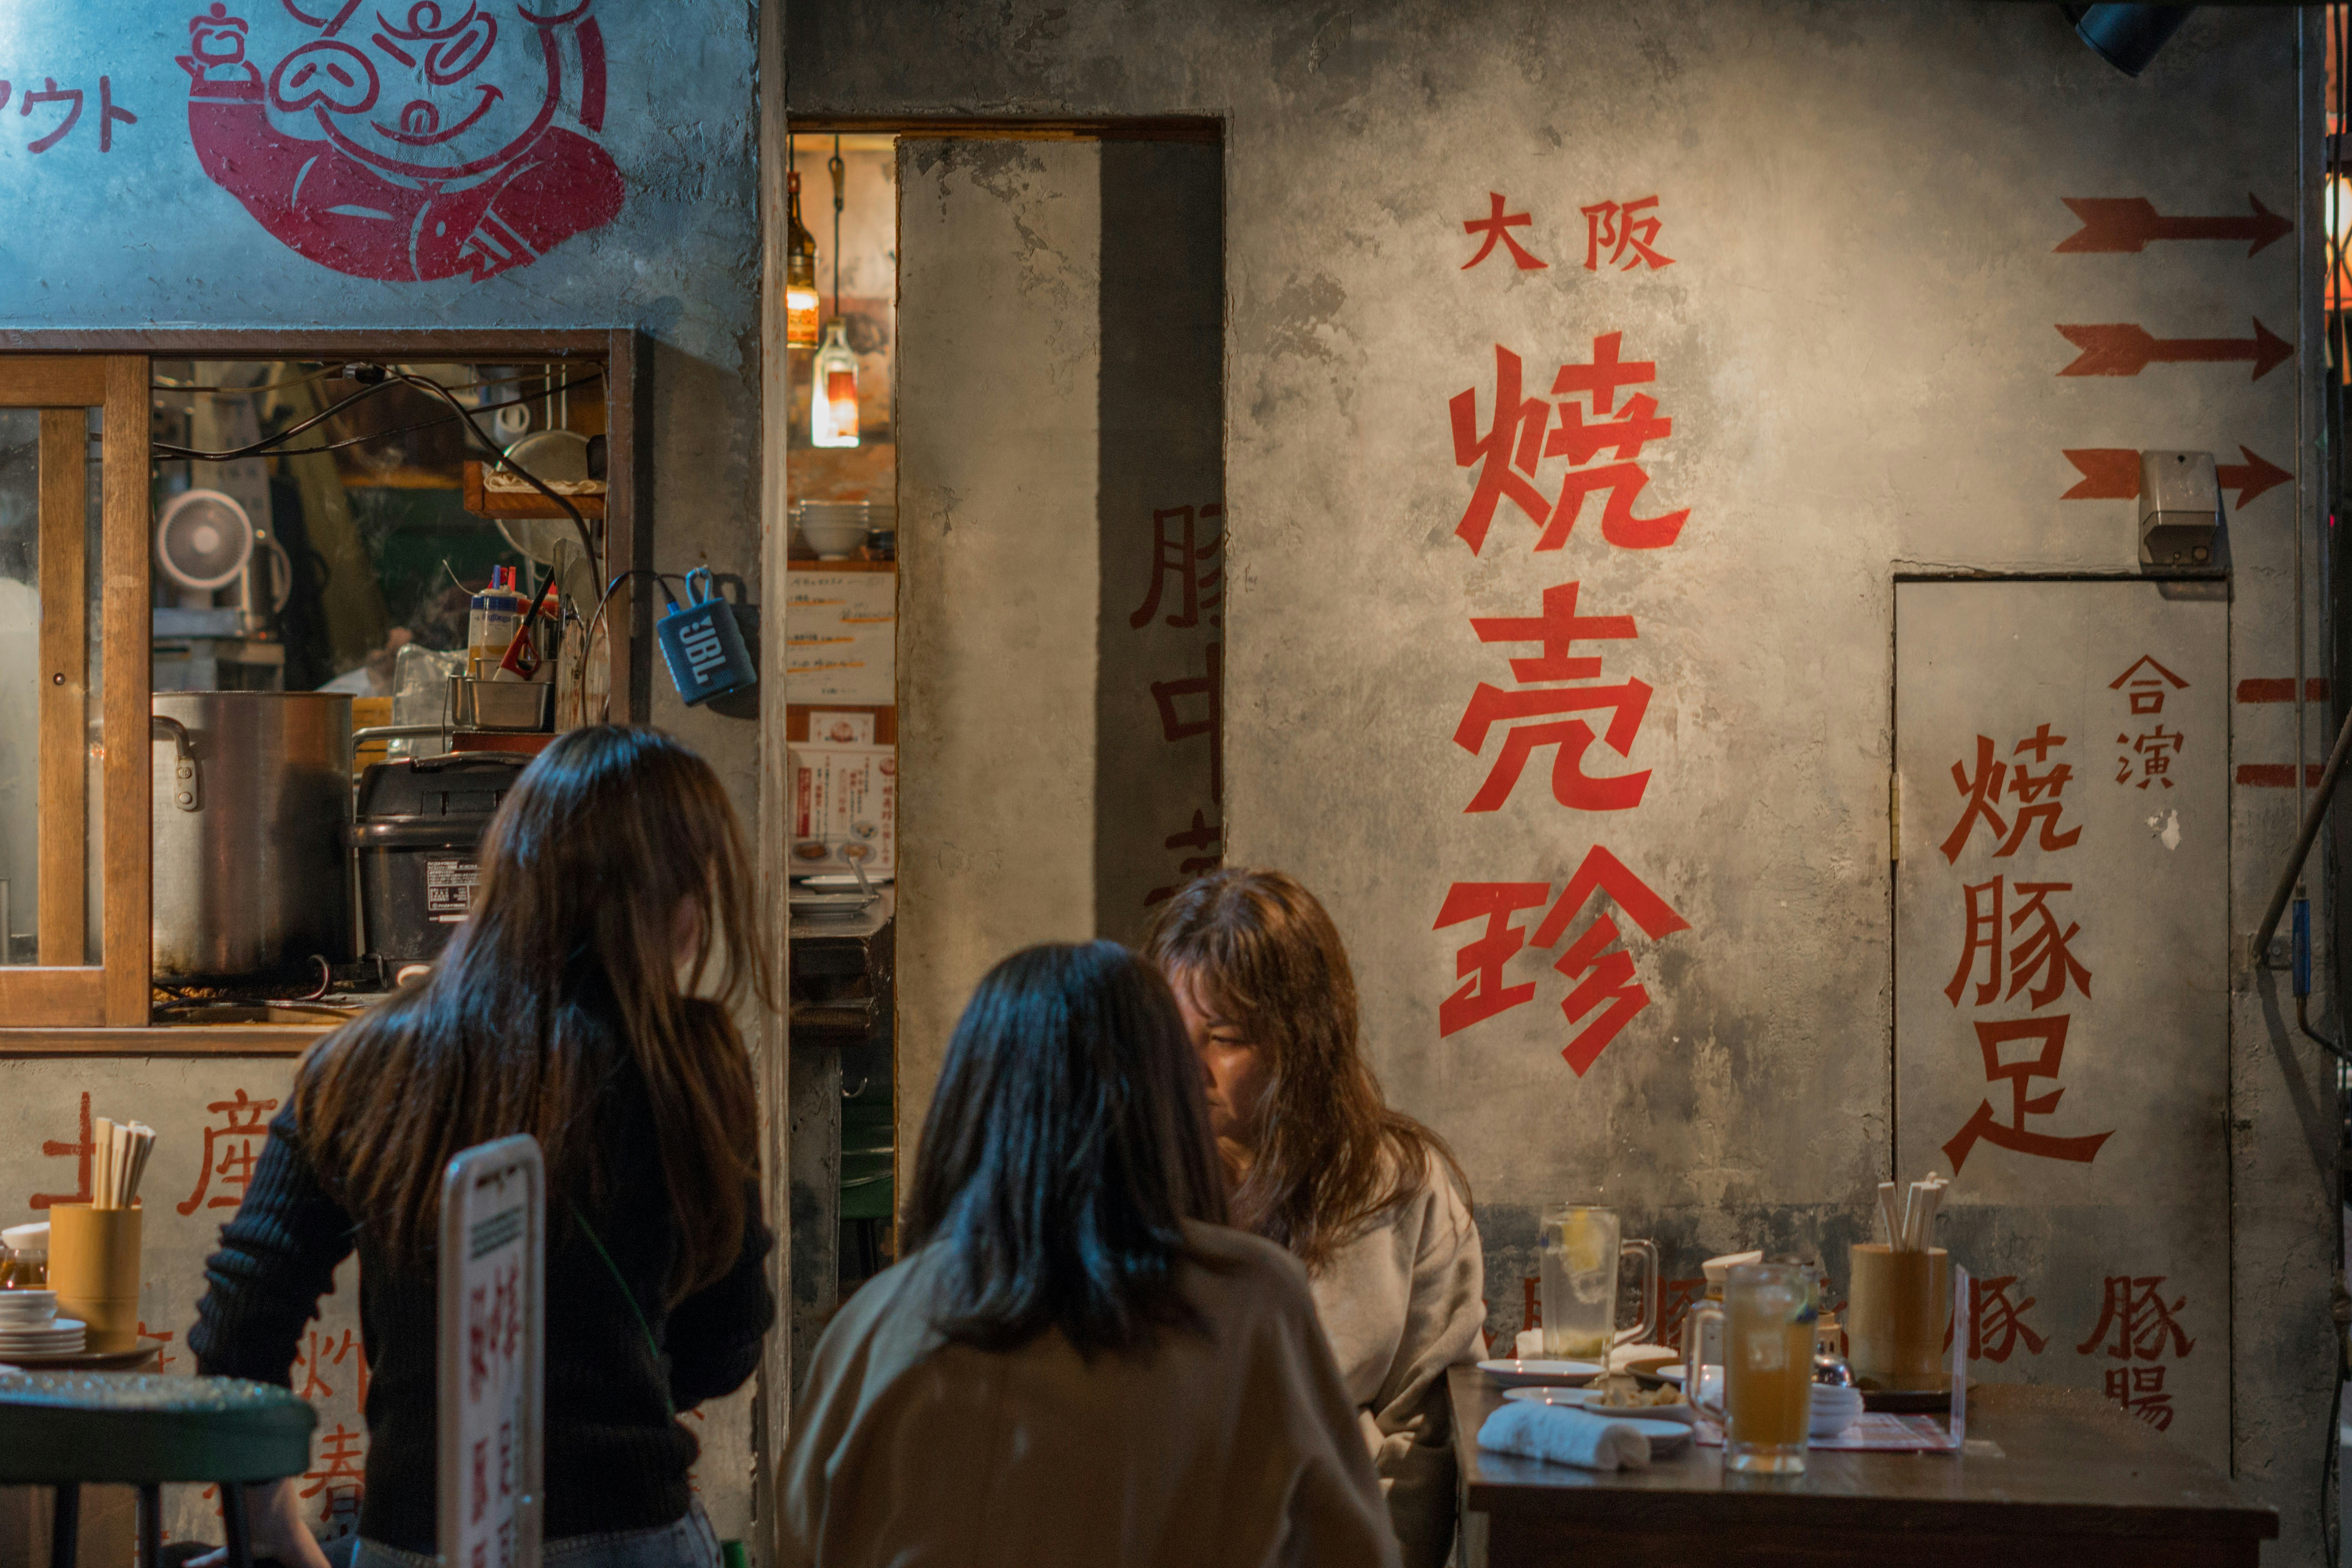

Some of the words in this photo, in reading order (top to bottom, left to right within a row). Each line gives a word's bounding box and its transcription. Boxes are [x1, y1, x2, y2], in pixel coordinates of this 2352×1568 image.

[1461, 191, 1676, 272] 大阪
[680, 615, 726, 684] JBL
[1432, 330, 1692, 1078] 焼売珍
[2109, 654, 2190, 789] 合演
[1939, 723, 2116, 1176] 焼豚足
